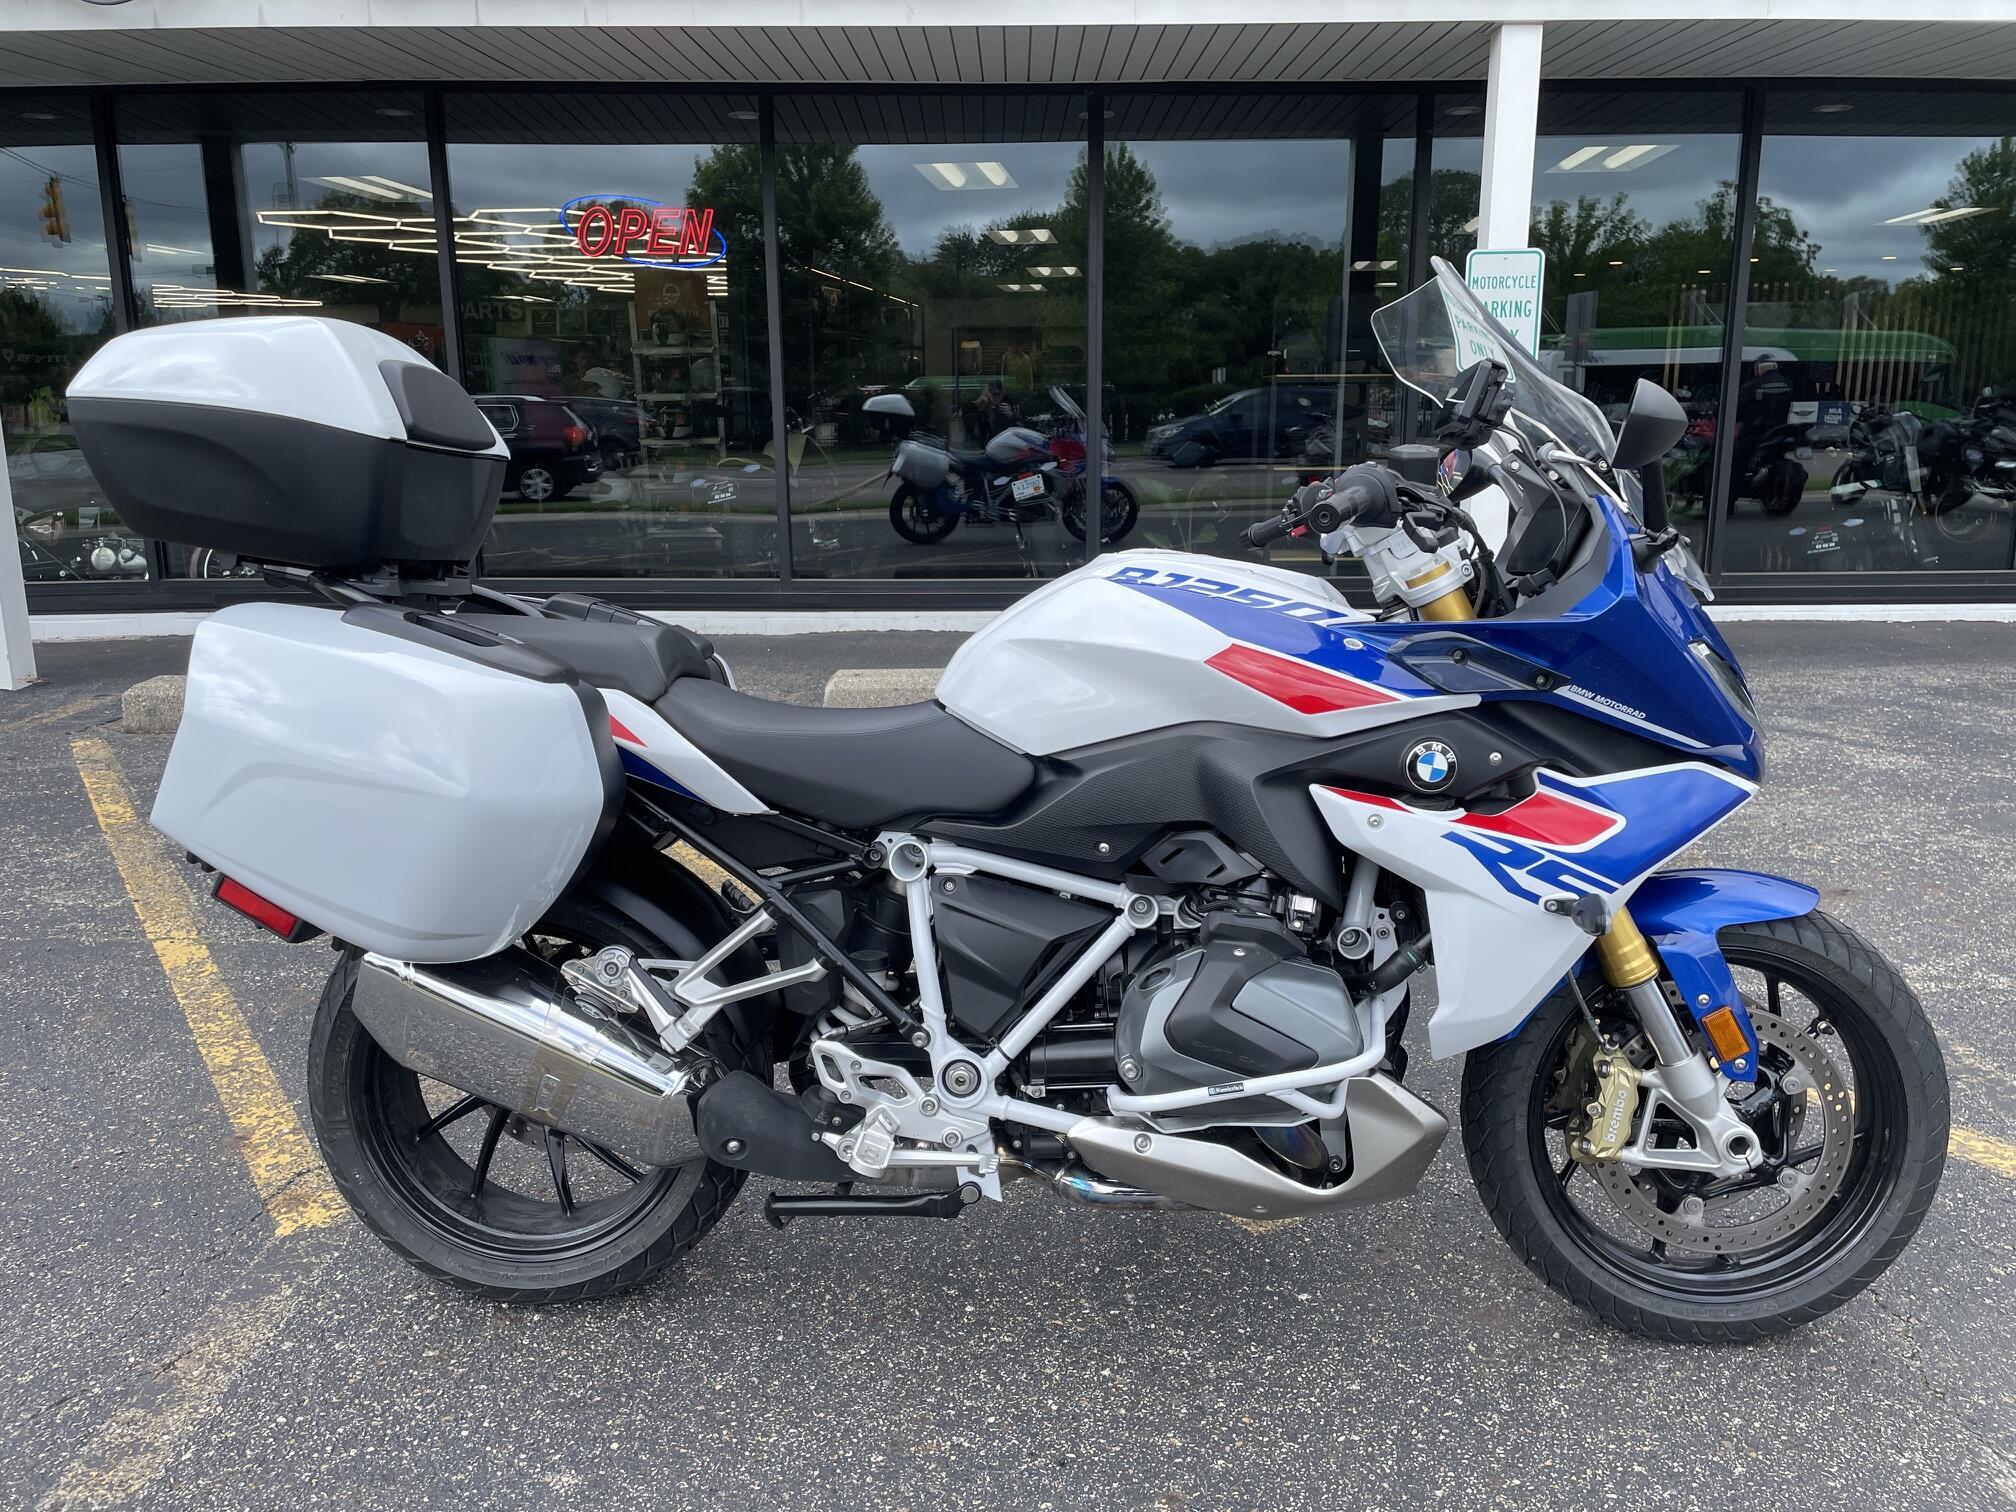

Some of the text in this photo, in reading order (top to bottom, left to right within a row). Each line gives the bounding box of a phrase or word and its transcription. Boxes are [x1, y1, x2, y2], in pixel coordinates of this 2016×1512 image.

[577, 206, 714, 257] OPEN
[1472, 275, 1537, 289] MOTORCYCLE
[460, 302, 523, 320] ARTS
[1483, 300, 1532, 318] RKING
[1569, 684, 1646, 719] BMW MOTORRAD
[1415, 743, 1456, 763] BMW
[1604, 1090, 1627, 1143] brembo
